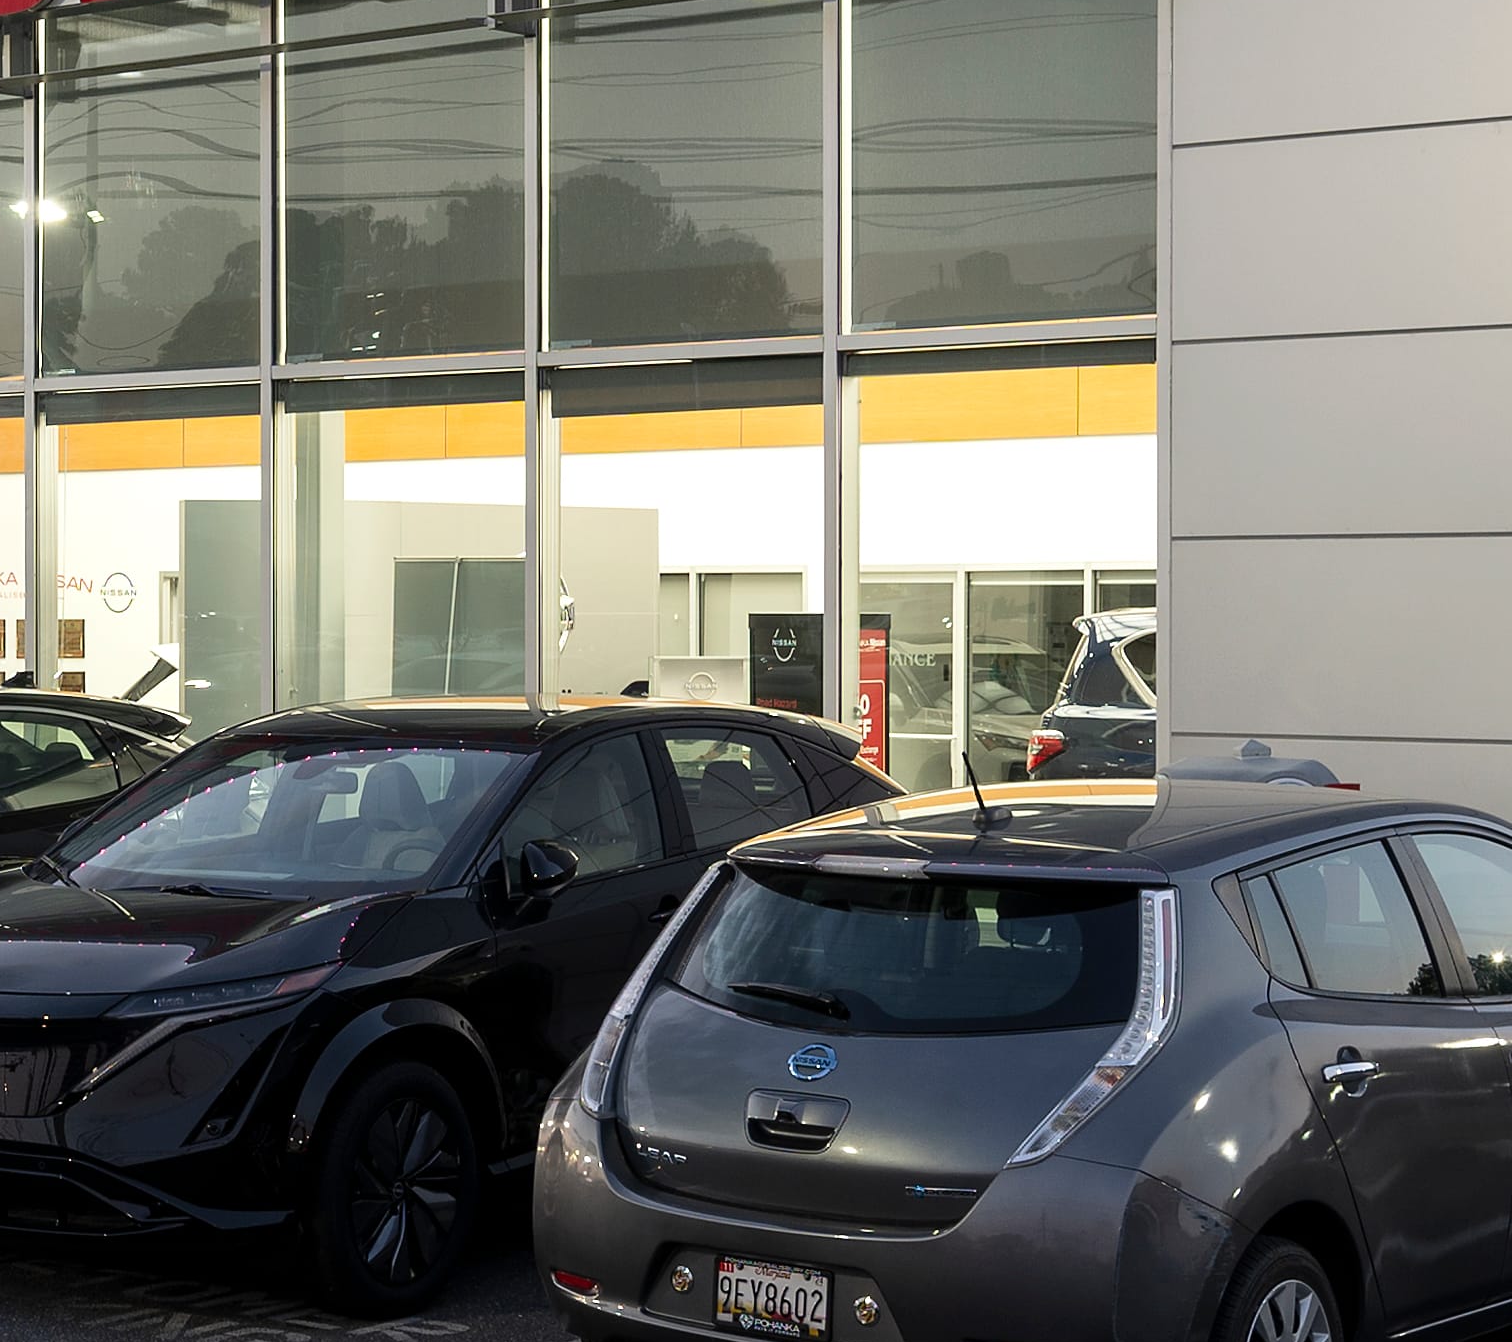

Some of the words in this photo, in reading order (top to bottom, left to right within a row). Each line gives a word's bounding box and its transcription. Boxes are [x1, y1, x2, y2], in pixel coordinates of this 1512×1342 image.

[57, 574, 93, 593] SAN
[100, 588, 137, 597] NISSAN
[772, 639, 797, 647] NISSAN
[890, 653, 936, 667] ANCE
[685, 682, 718, 691] NISSAN
[793, 1056, 832, 1066] NISSAN
[636, 1144, 687, 1163] LEAF
[720, 1275, 823, 1323] 9EY8602
[754, 1318, 800, 1332] POHANKA
